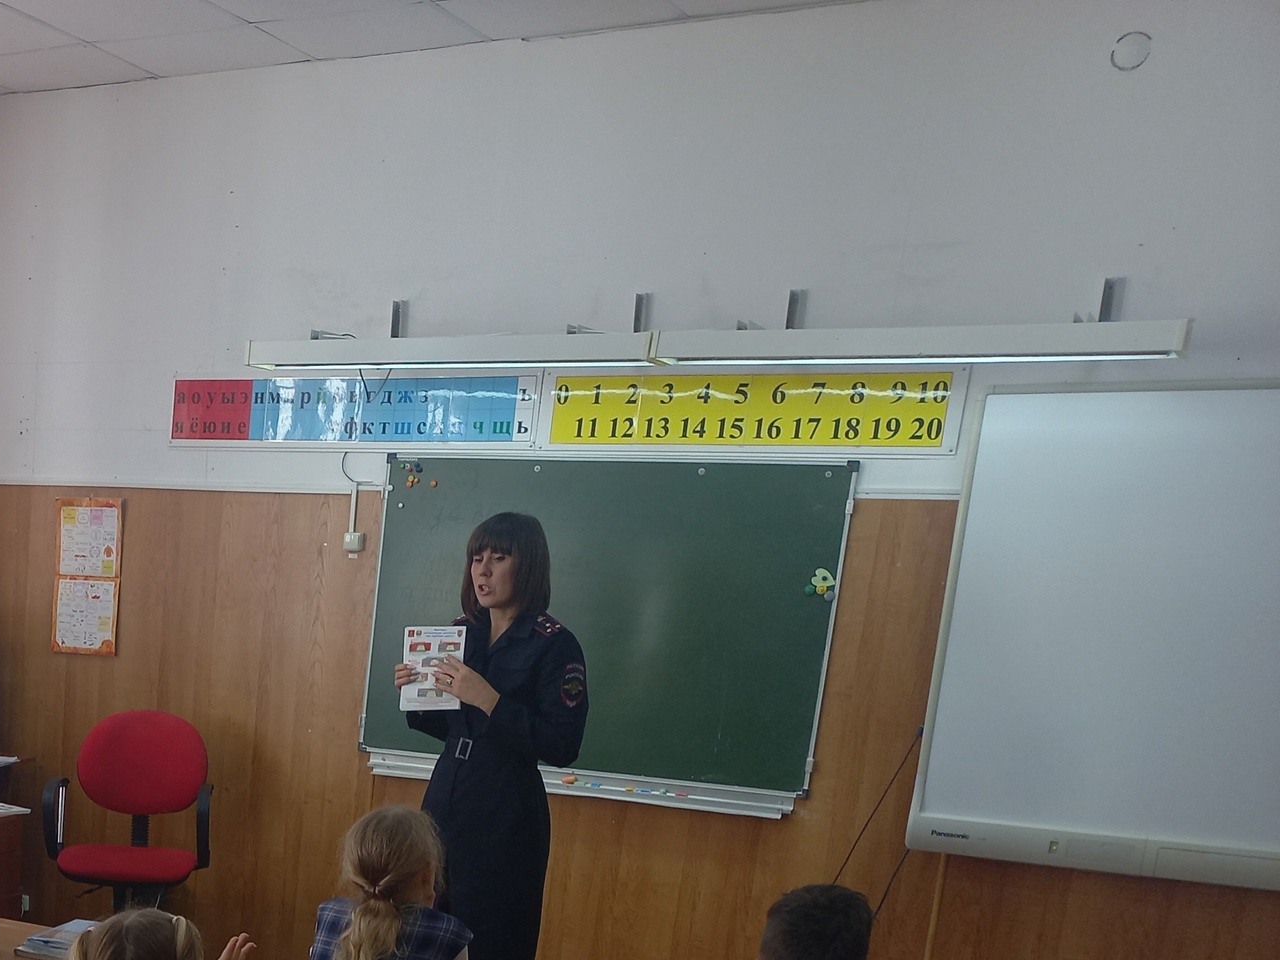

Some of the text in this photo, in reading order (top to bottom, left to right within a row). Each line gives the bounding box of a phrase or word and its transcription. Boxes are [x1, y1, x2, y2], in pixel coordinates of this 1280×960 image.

[556, 380, 949, 405] 0 1 2 3 4 5 6 7 8 9 10
[573, 417, 943, 441] 11 12 13 14 15 16 17 18 19 20
[931, 829, 969, 839] Panasonic
